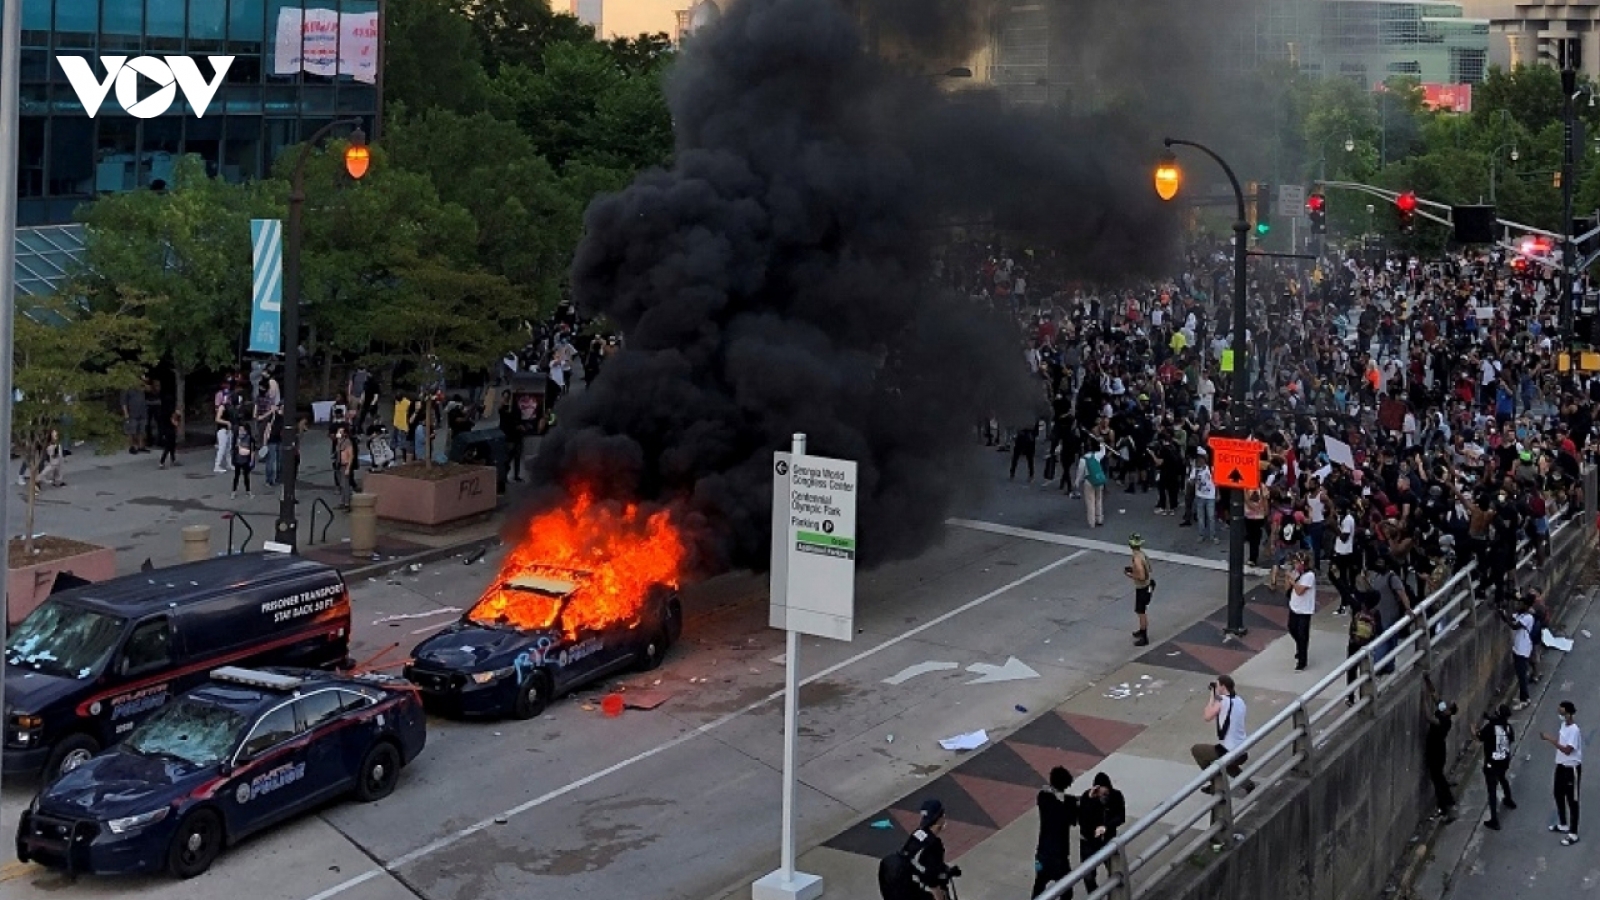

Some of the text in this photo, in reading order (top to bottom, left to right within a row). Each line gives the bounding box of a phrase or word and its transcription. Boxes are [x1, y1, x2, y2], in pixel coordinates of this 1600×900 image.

[1217, 453, 1256, 467] DETOUR
[793, 464, 845, 481] Georgia World
[792, 475, 854, 492] Congress Center
[791, 490, 832, 505] Centennial
[791, 501, 842, 517] Olympic Park
[791, 515, 820, 532] Parking
[261, 583, 345, 614] PRISONER TRANSPORT
[274, 609, 292, 624] STAY
[292, 603, 314, 618] BACK
[250, 762, 306, 801] POLICE
